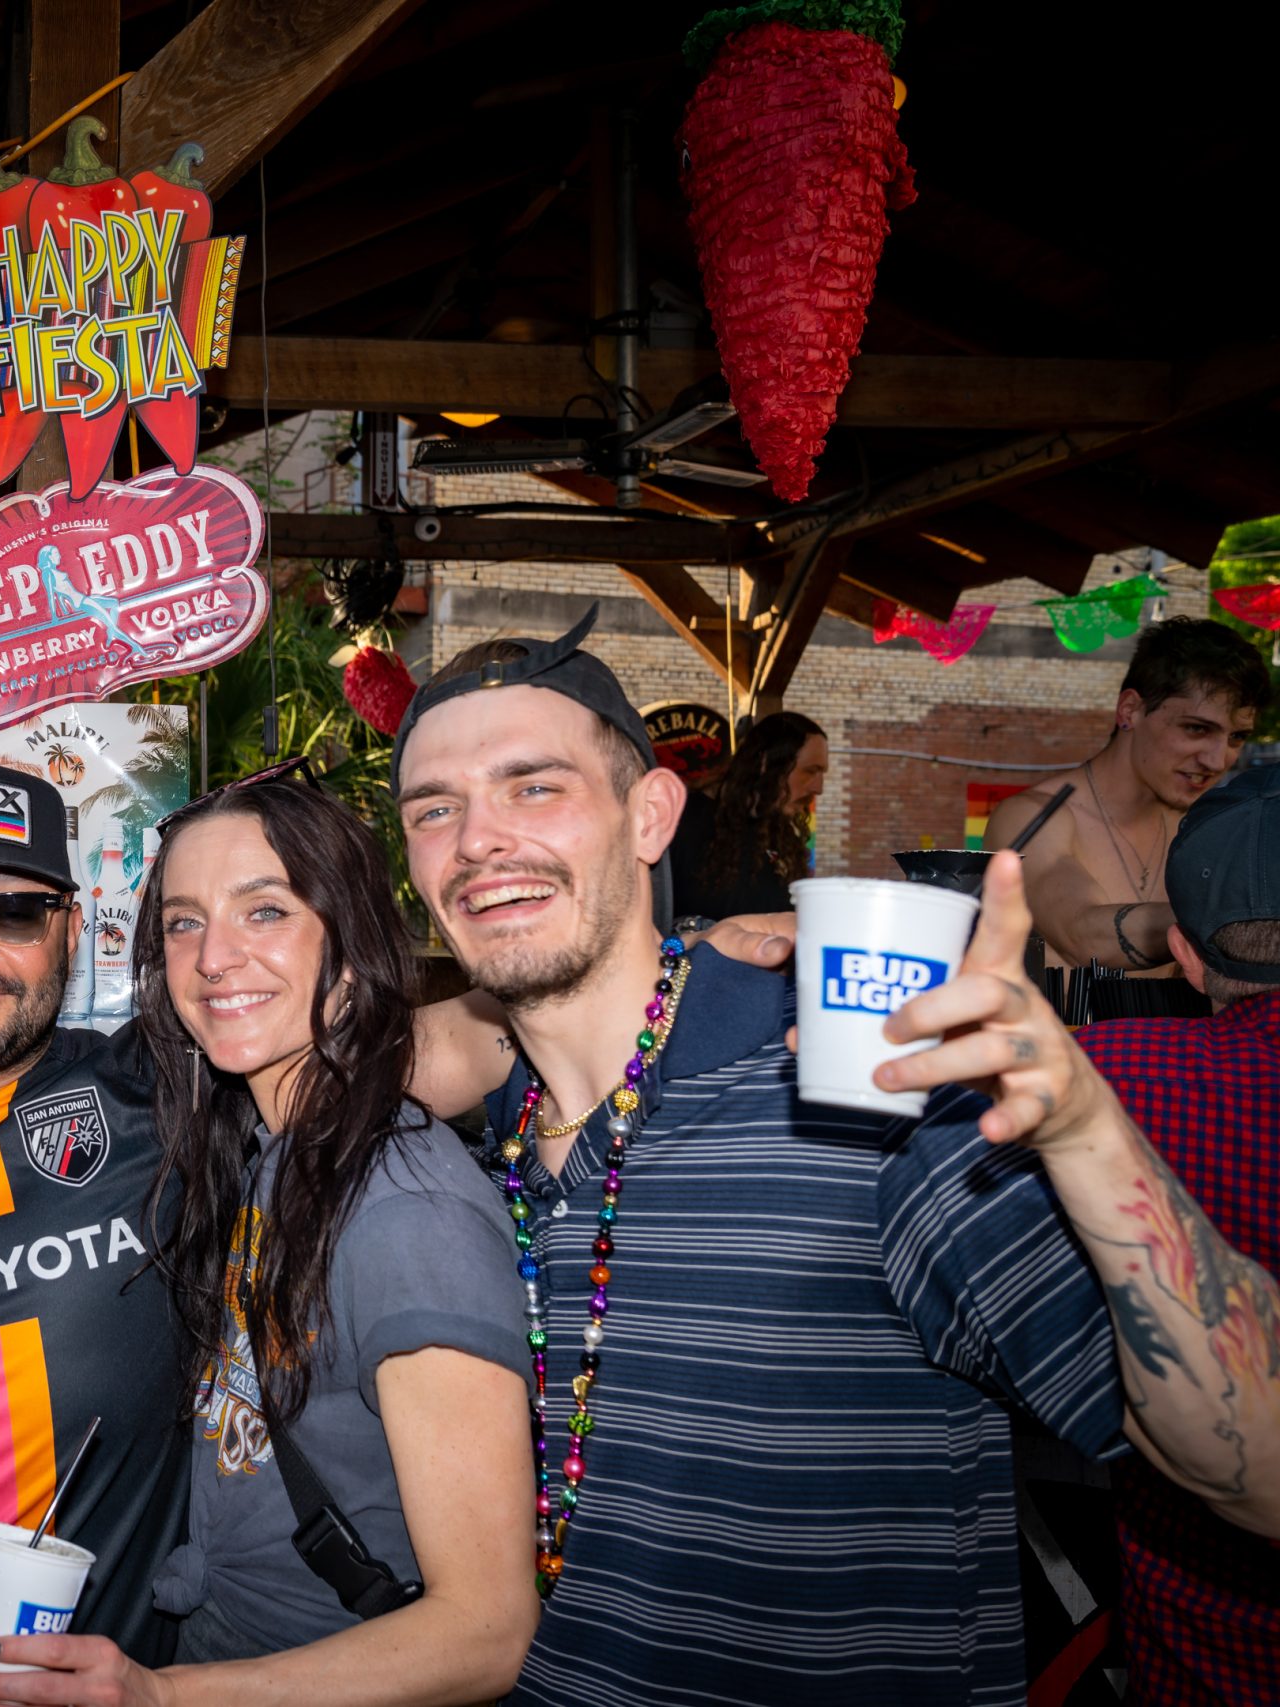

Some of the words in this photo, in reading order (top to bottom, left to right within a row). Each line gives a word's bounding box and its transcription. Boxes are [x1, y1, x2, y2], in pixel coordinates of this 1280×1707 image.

[52, 518, 110, 533] ORIGINAL
[78, 509, 214, 595] EDDY
[130, 588, 232, 632] VODKA
[176, 615, 237, 642] VODKA
[45, 650, 120, 681] INFUSED
[645, 711, 721, 740] REBALL
[95, 907, 136, 927] ALIBU
[94, 960, 129, 968] TRAWBERRY
[841, 952, 932, 990] BUD
[825, 977, 920, 1013] LIGH
[26, 1109, 48, 1124] SAN
[48, 1099, 90, 1117] ANTONIO
[33, 1609, 73, 1633] BU
